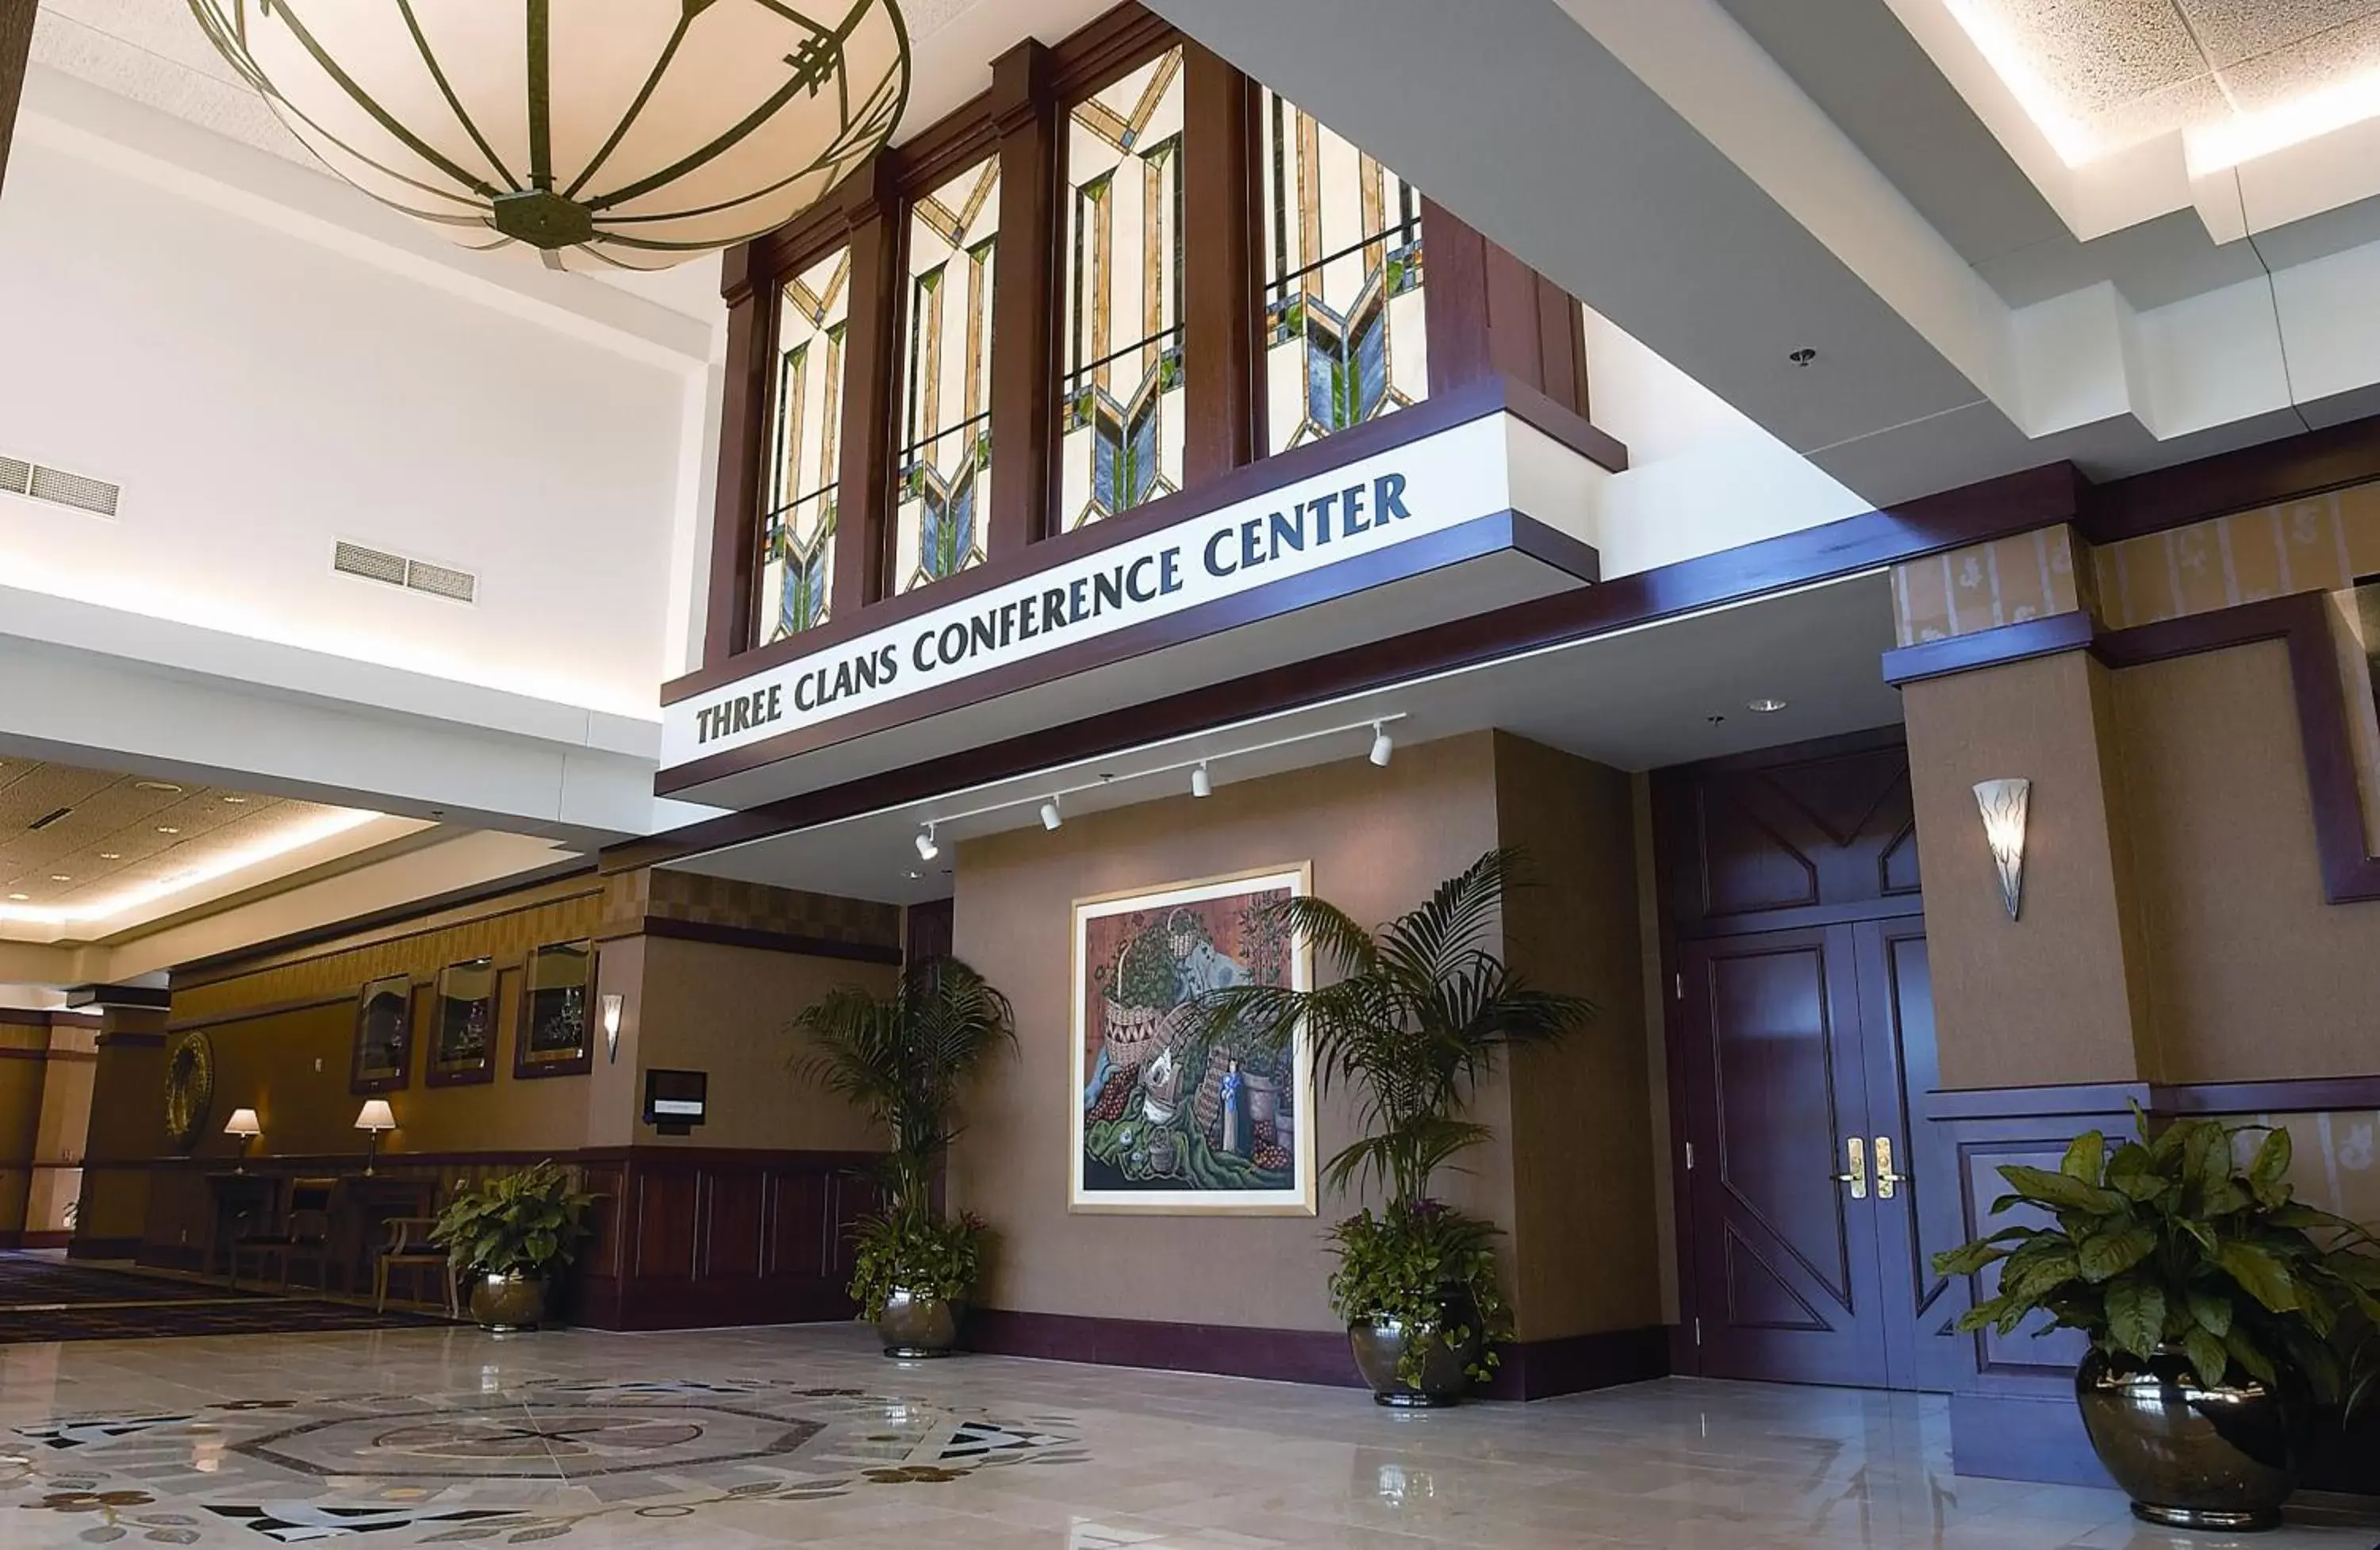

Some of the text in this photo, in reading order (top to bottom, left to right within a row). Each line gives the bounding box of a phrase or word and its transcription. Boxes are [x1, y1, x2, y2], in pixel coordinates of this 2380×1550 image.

[697, 473, 1411, 744] THREE CLANS CONFERENCE CENTER
